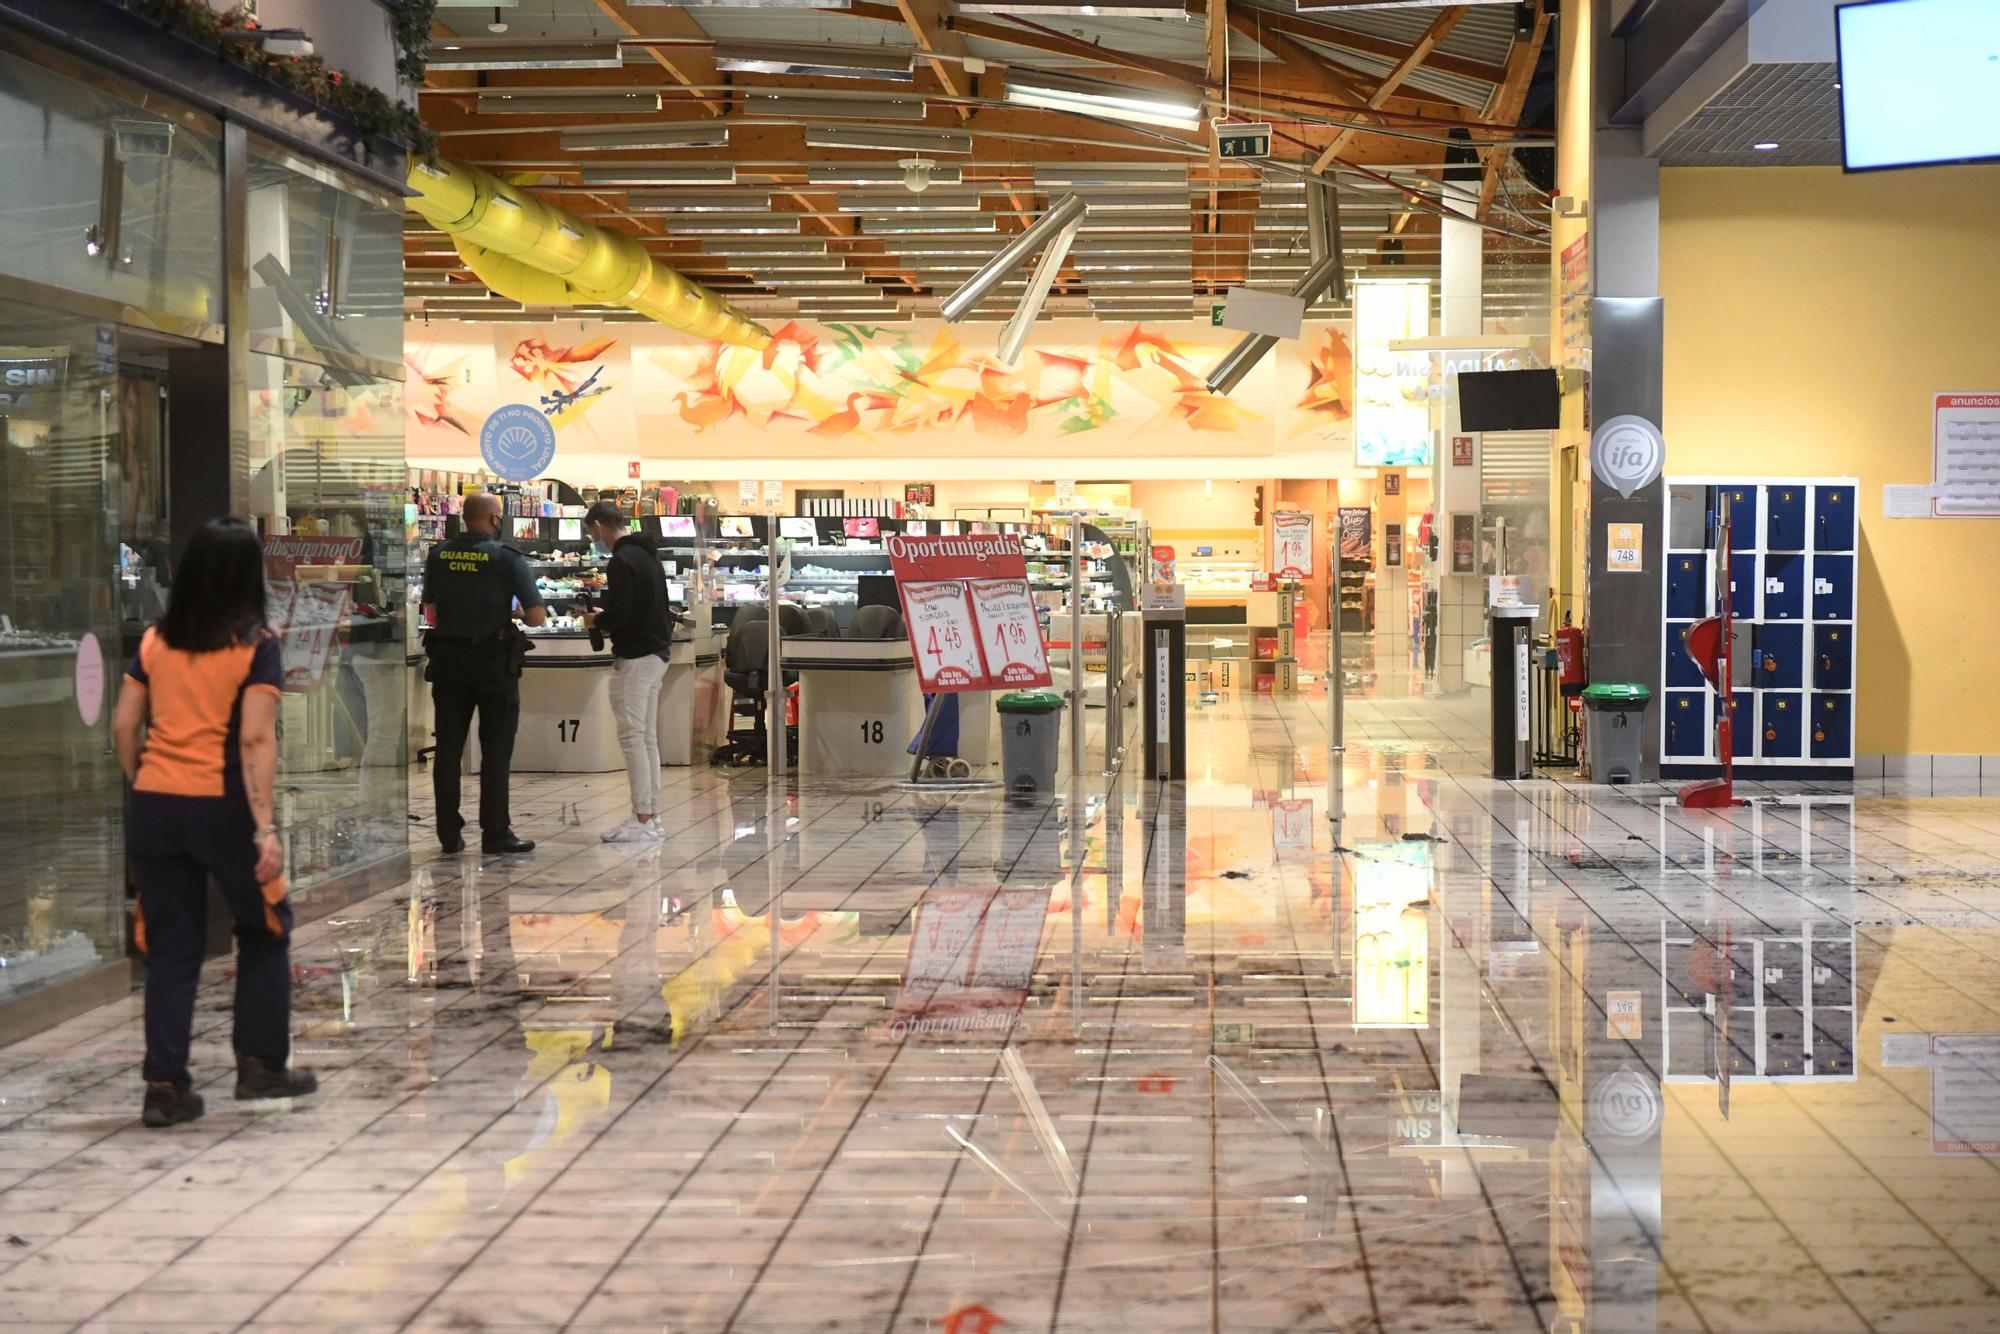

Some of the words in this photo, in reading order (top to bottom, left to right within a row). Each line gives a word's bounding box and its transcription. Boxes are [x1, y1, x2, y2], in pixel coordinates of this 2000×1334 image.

[1951, 395, 1999, 406] anuncios
[1611, 445, 1643, 469] ifa
[440, 550, 489, 561] GUARDIA
[889, 534, 1021, 563] Oportunigadis
[1617, 550, 1634, 561] 748
[449, 561, 478, 572] CIVIL
[558, 719, 580, 742] 17
[861, 720, 884, 744] 18
